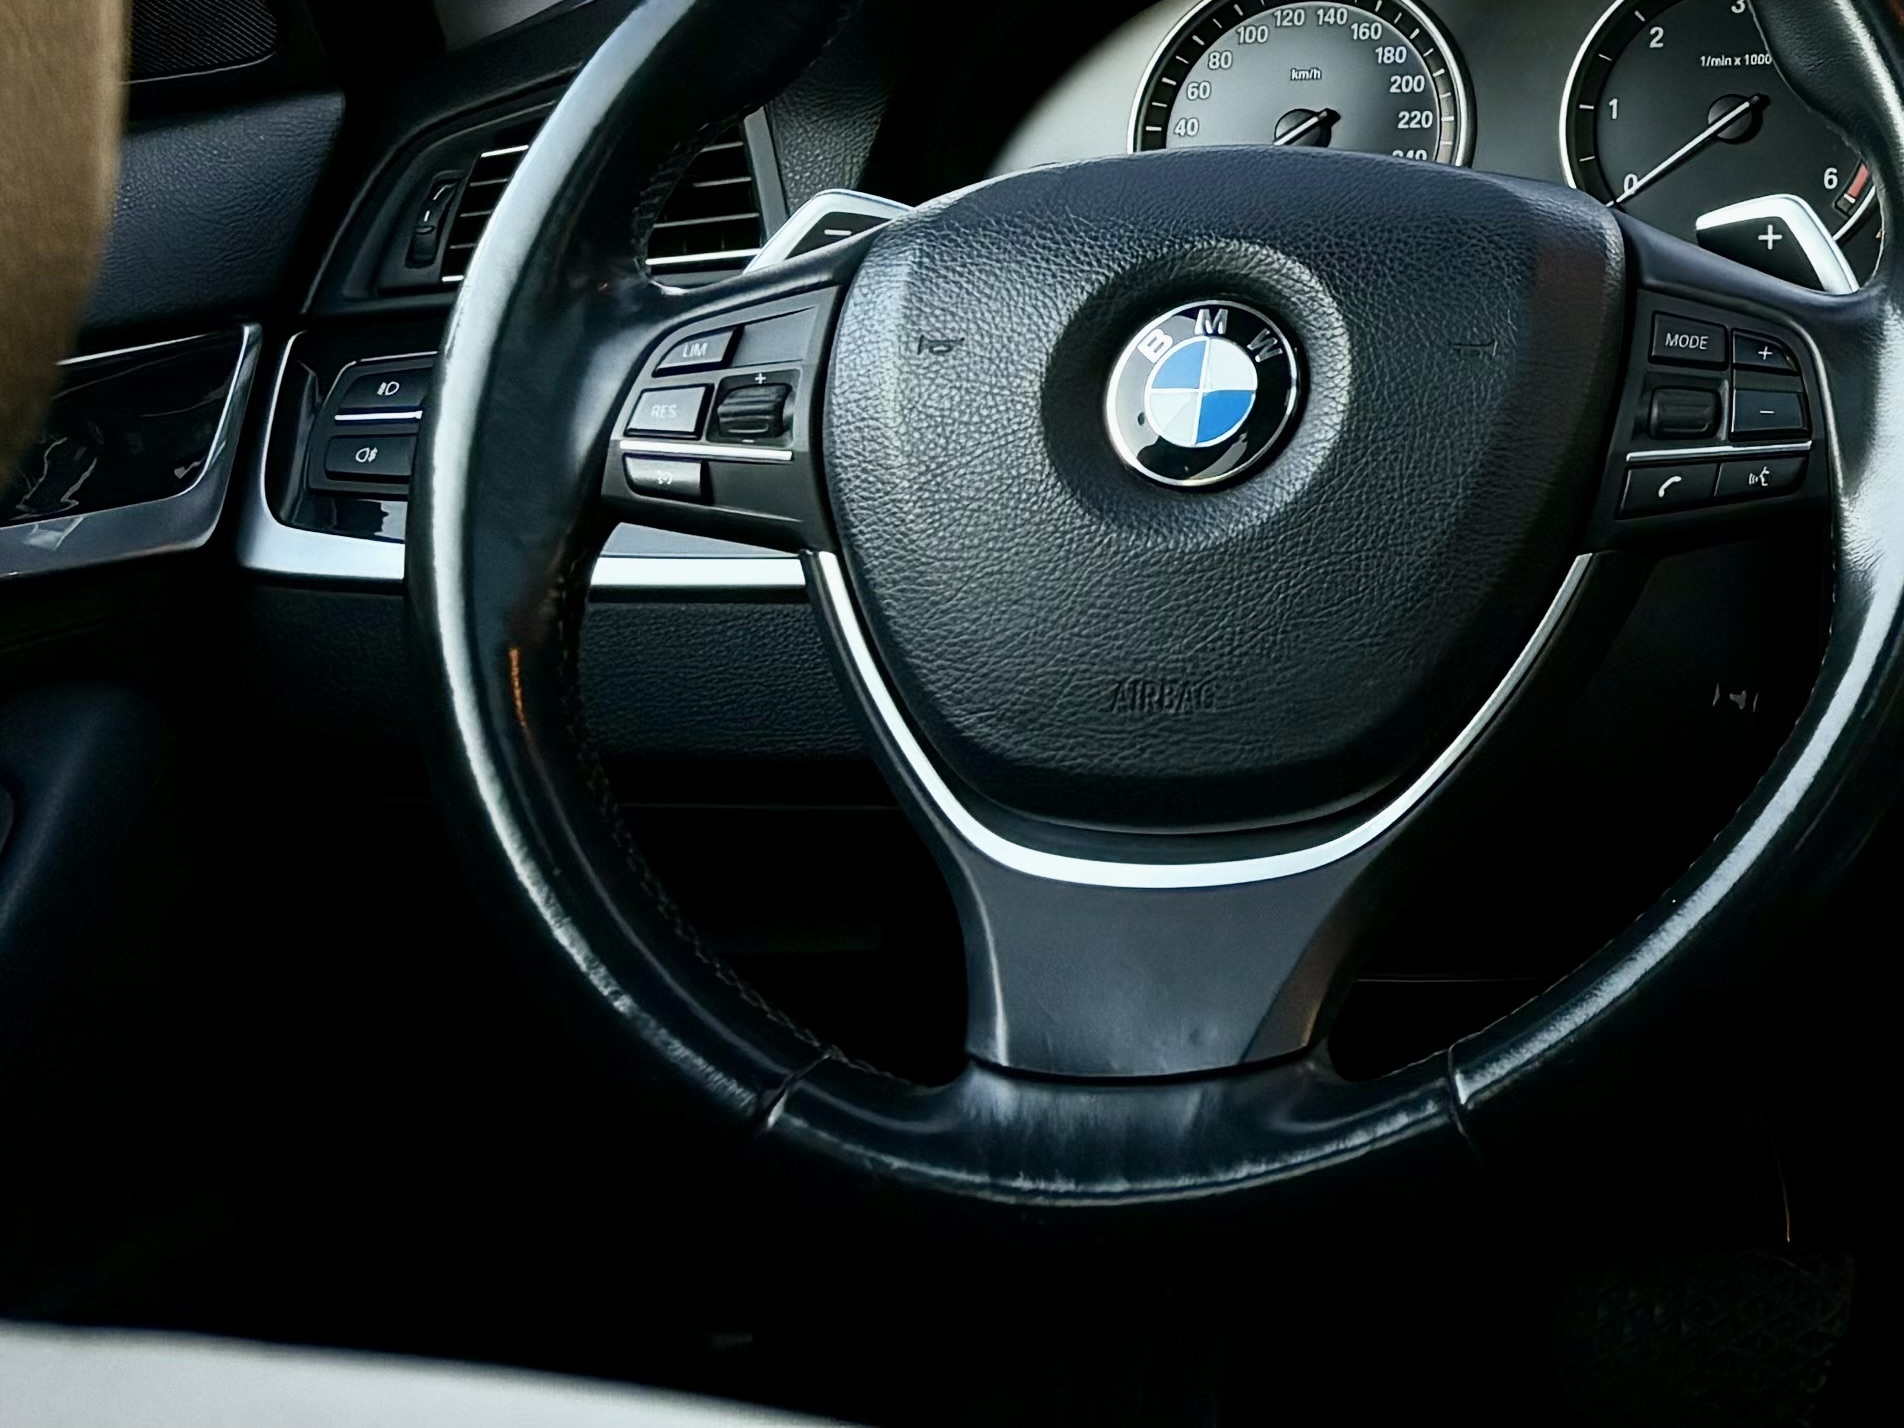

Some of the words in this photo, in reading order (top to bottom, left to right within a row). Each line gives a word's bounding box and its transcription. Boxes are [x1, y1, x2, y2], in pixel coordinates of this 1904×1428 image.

[1273, 8, 1305, 27] 120
[1316, 8, 1348, 25] 140
[1237, 25, 1269, 43] 100
[1350, 22, 1382, 40] 160
[1648, 26, 1665, 49] 2
[1208, 51, 1232, 69] 80
[1375, 46, 1407, 64] 180
[1700, 54, 1732, 67] 1/min
[1734, 57, 1741, 66] x
[1744, 53, 1772, 65] 1000
[1290, 68, 1322, 81] km/h
[1187, 81, 1211, 100] 60
[1389, 75, 1425, 93] 200
[1608, 98, 1619, 121] 1
[1174, 118, 1199, 136] 40
[1397, 110, 1433, 129] 220
[1623, 173, 1638, 195] 0
[1823, 167, 1838, 190] 6
[1136, 308, 1284, 364] BMW
[1664, 332, 1710, 350] MODE
[650, 404, 678, 419] RES
[1111, 681, 1217, 713] AIRBAG
